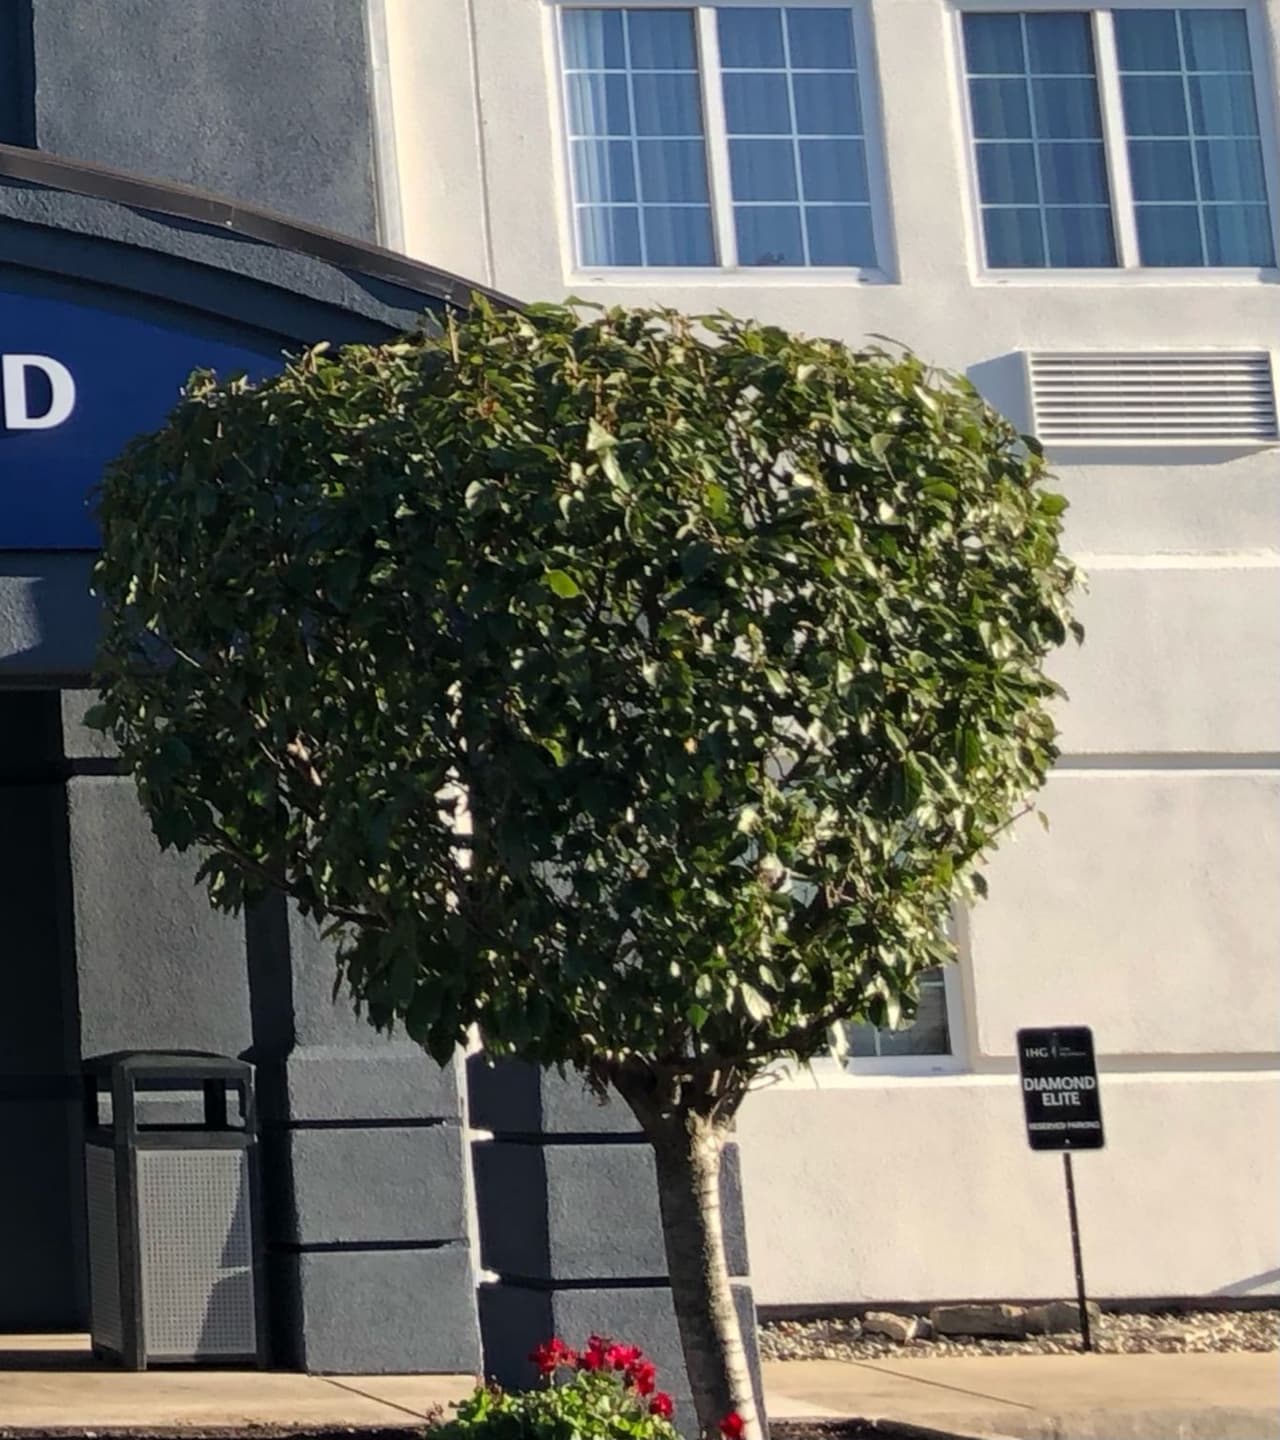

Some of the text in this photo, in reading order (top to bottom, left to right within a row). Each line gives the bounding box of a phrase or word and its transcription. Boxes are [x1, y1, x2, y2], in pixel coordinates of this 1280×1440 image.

[1025, 1047, 1049, 1058] IHG
[1023, 1076, 1096, 1091] DIAMOND
[1041, 1091, 1081, 1106] ELITE
